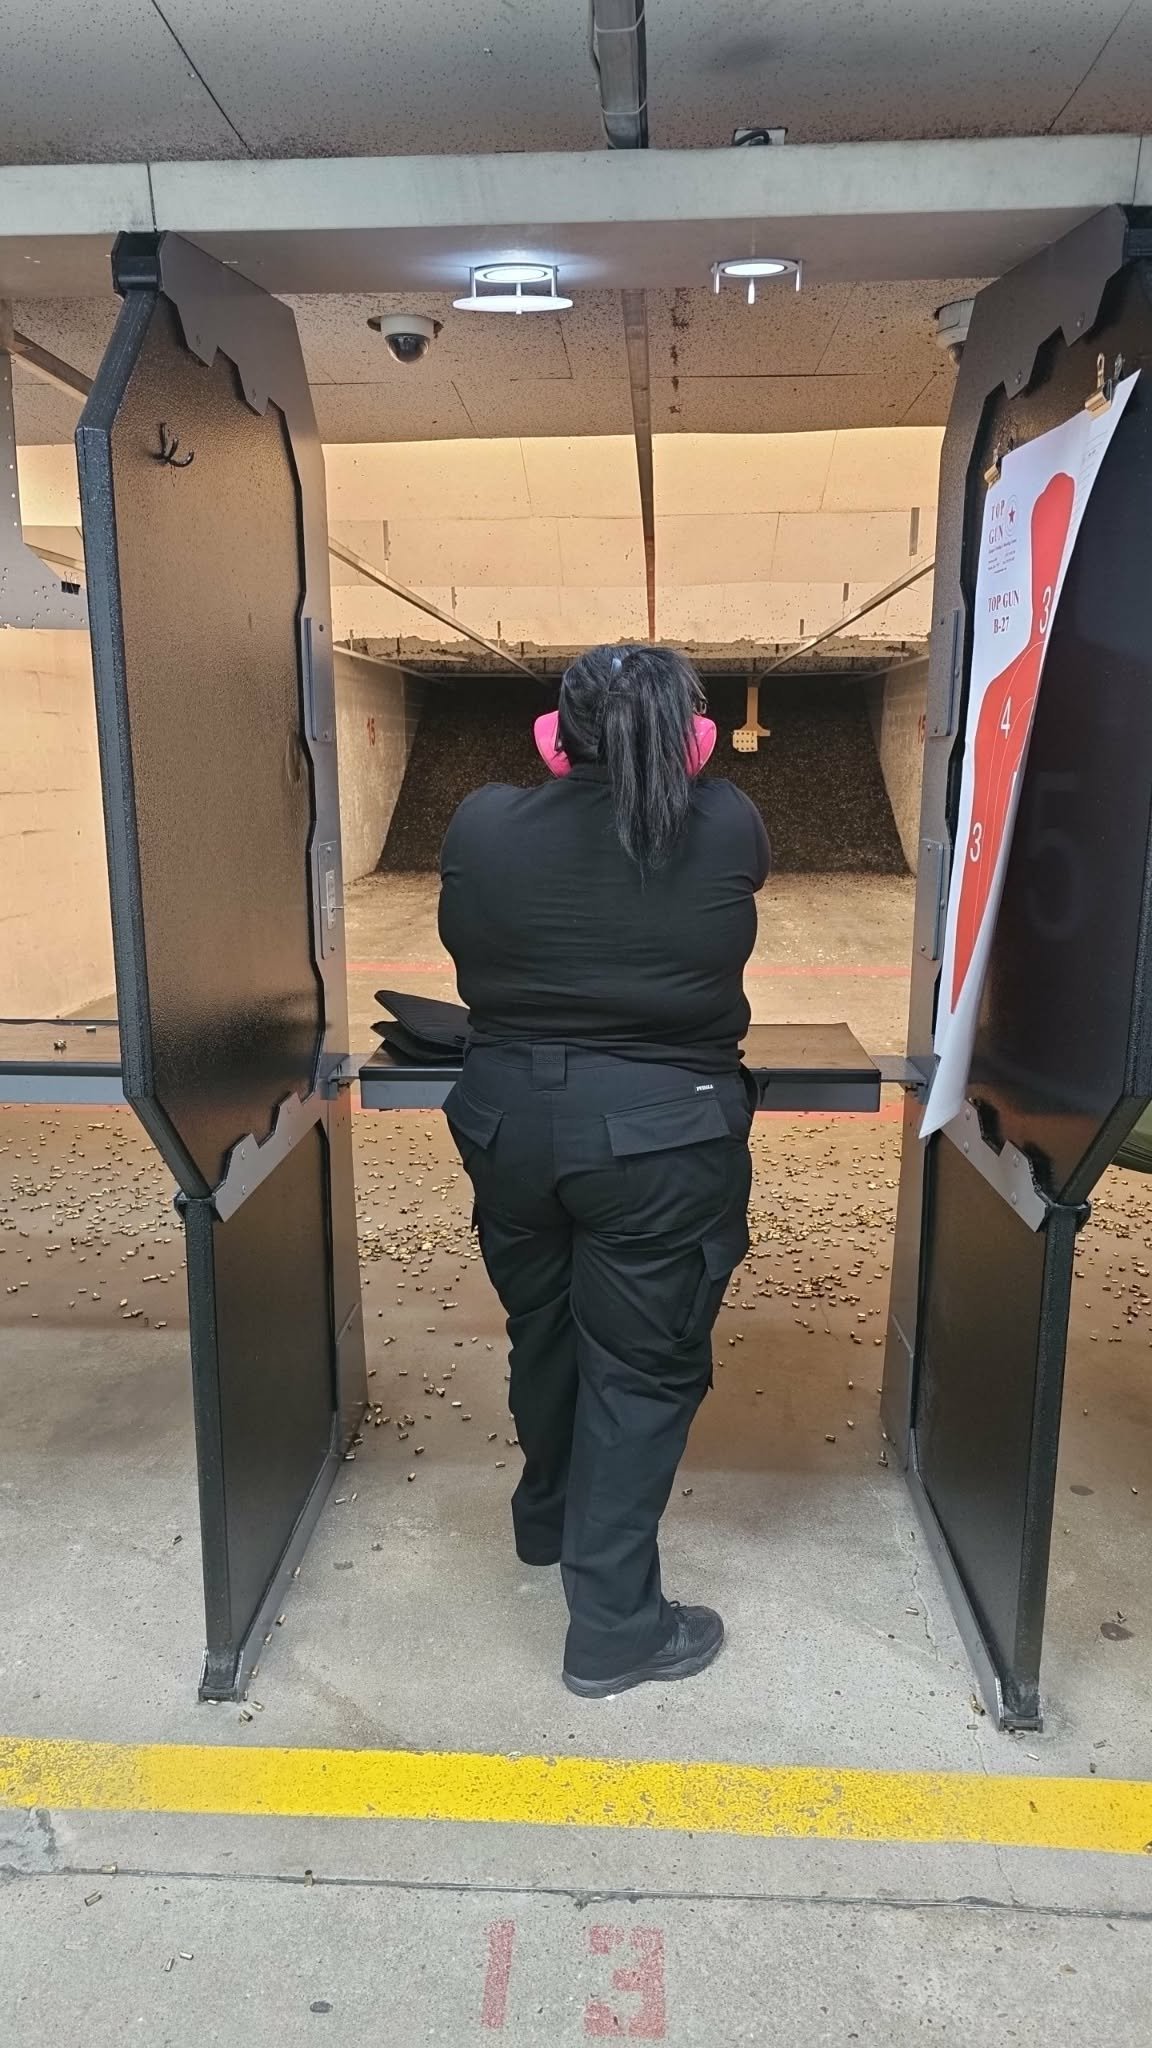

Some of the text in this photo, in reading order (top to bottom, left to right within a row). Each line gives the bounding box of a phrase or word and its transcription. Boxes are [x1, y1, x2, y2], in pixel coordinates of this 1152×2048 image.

[991, 499, 1005, 521] TOP
[988, 525, 1004, 545] GUN
[988, 589, 1020, 613] TOP GUN
[1039, 585, 1052, 635] 3
[993, 615, 1010, 634] B-27
[366, 717, 376, 747] 15
[1000, 696, 1012, 740] 4
[969, 822, 983, 862] 3
[480, 1918, 666, 2039] 13
